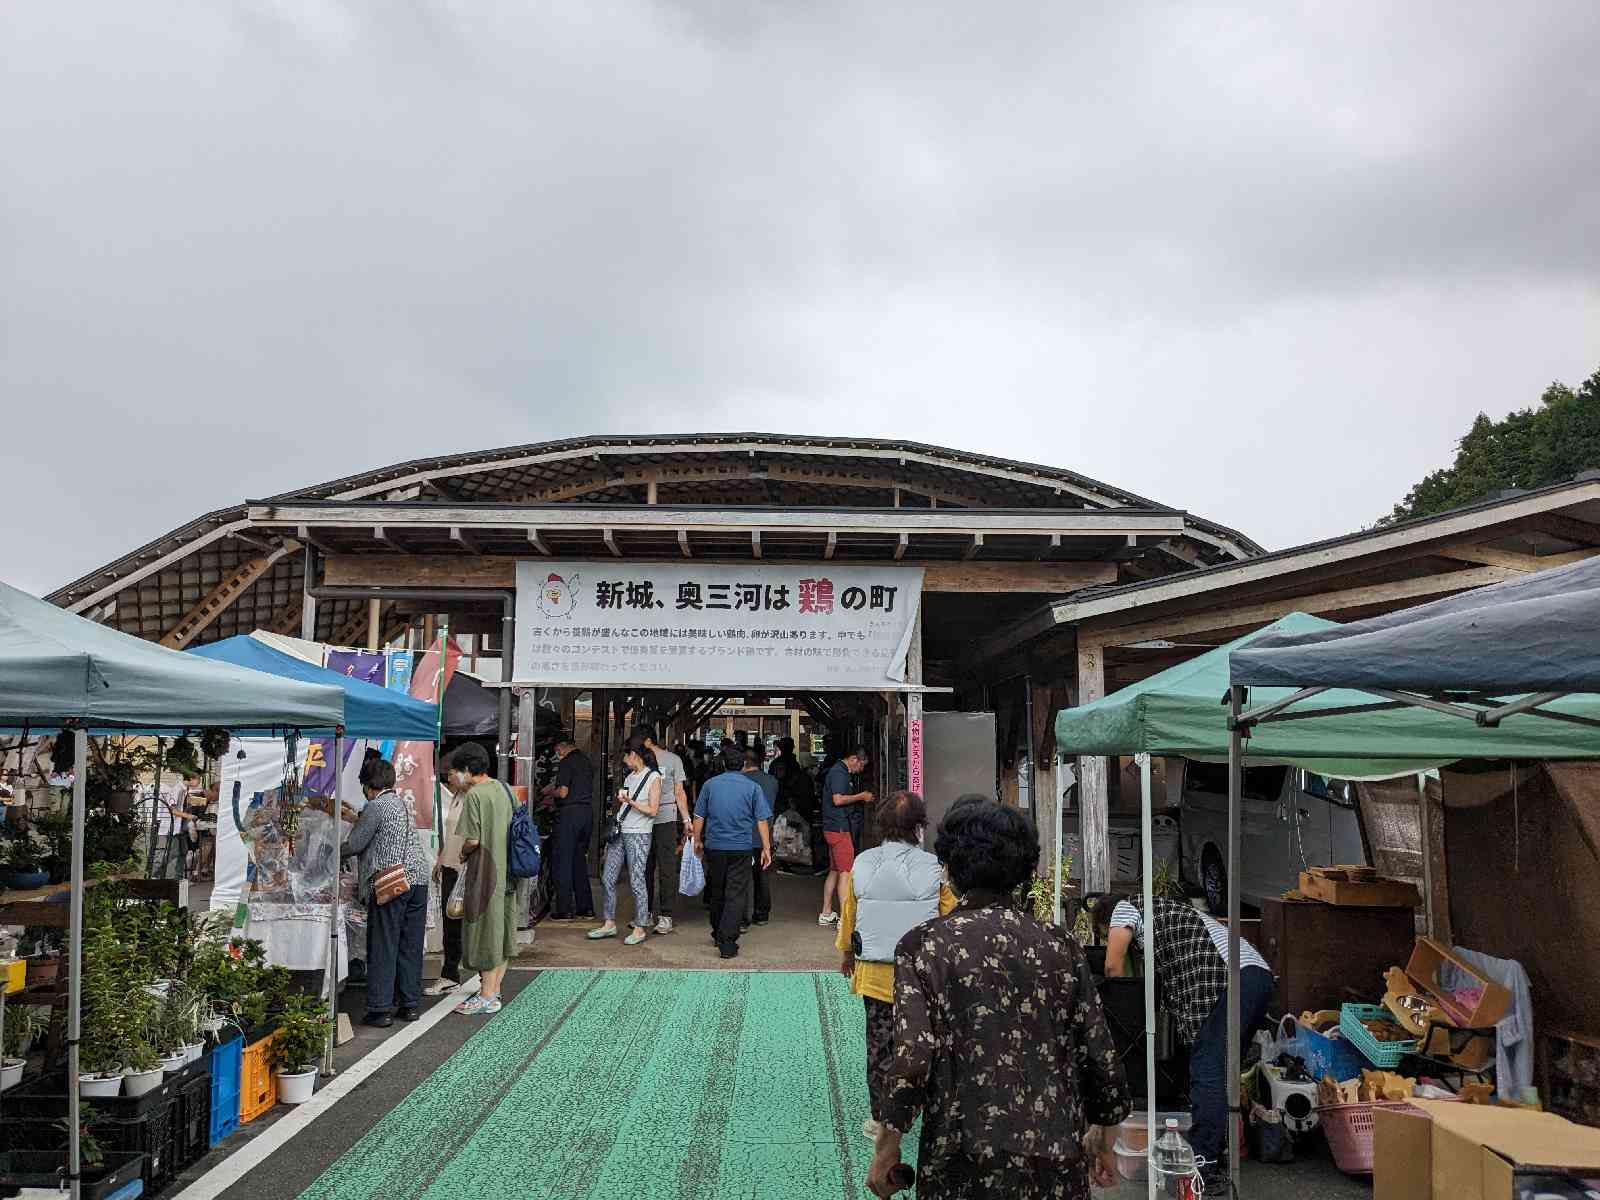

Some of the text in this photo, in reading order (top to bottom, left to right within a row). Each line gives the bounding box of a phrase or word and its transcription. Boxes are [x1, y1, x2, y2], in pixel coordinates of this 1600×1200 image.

[596, 578, 897, 615] 新城、奥三河は鶏の町
